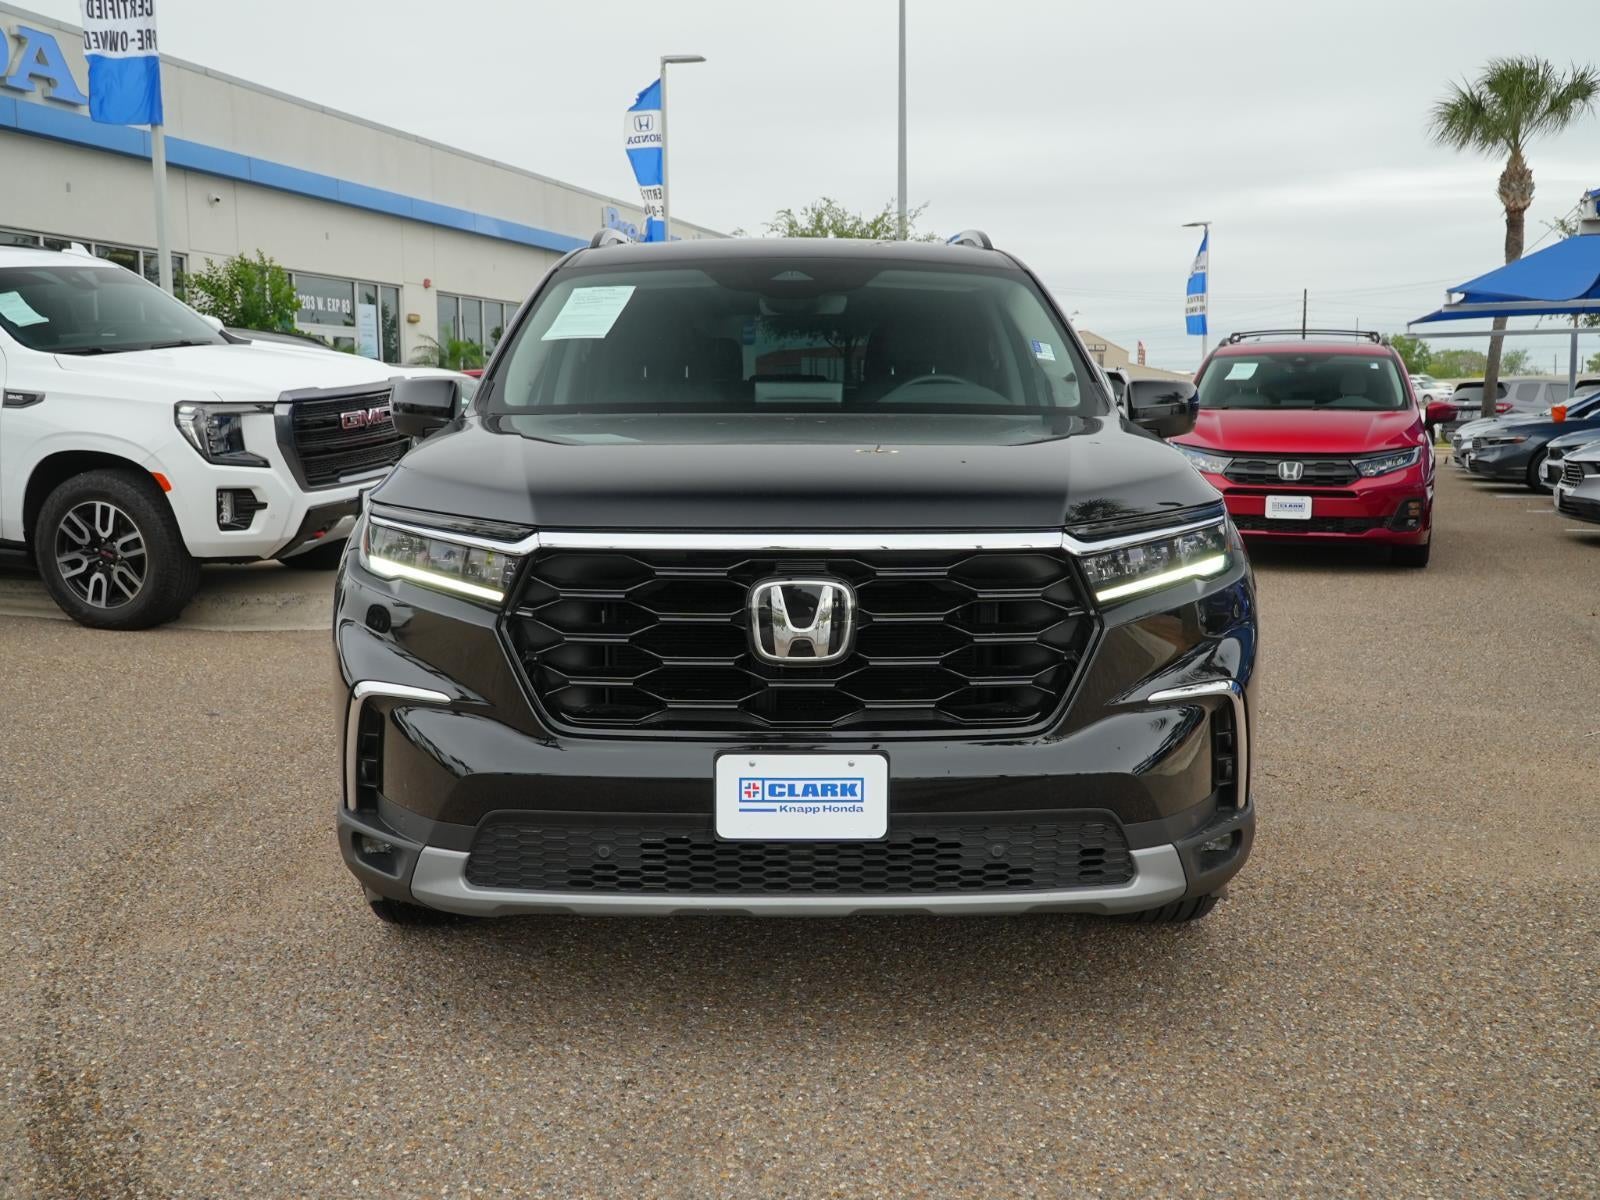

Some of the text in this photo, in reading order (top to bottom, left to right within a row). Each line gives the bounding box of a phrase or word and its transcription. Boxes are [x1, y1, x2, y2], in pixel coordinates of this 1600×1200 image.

[327, 297, 341, 313] EXP
[768, 783, 858, 798] CLARK
[779, 804, 864, 815] Knapp Honda
